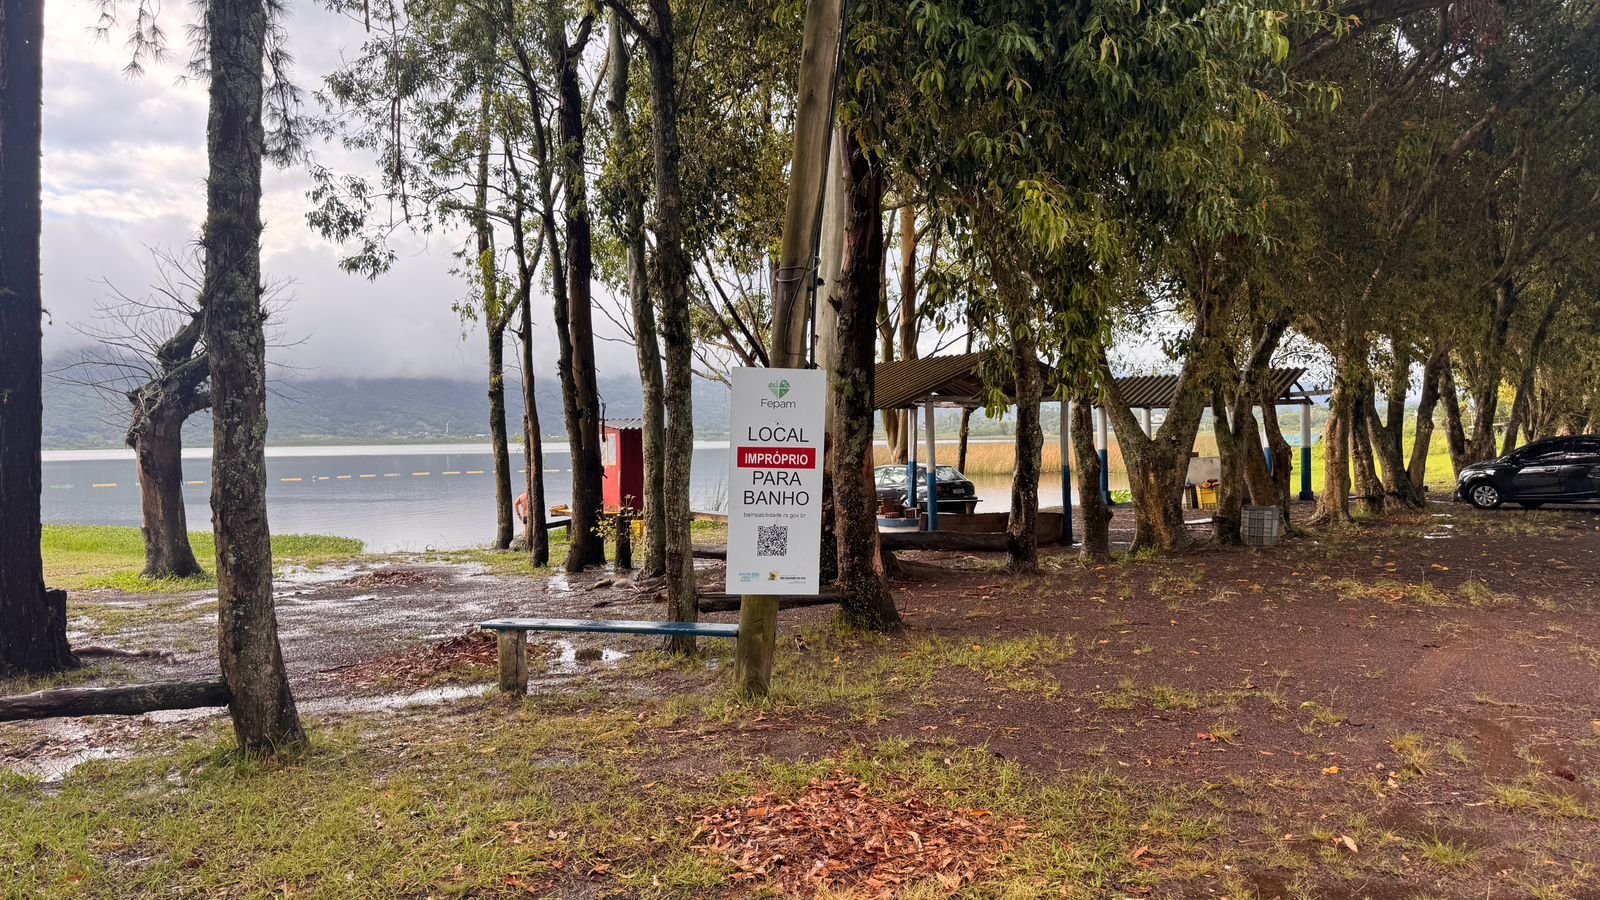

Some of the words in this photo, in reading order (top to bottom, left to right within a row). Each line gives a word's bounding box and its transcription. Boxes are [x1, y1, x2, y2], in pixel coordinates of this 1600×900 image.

[760, 398, 797, 409] Fepam
[748, 426, 809, 443] LOCAL
[744, 451, 809, 466] IMPRÓPRIO
[752, 470, 802, 486] PARA
[743, 490, 810, 506] BANHO
